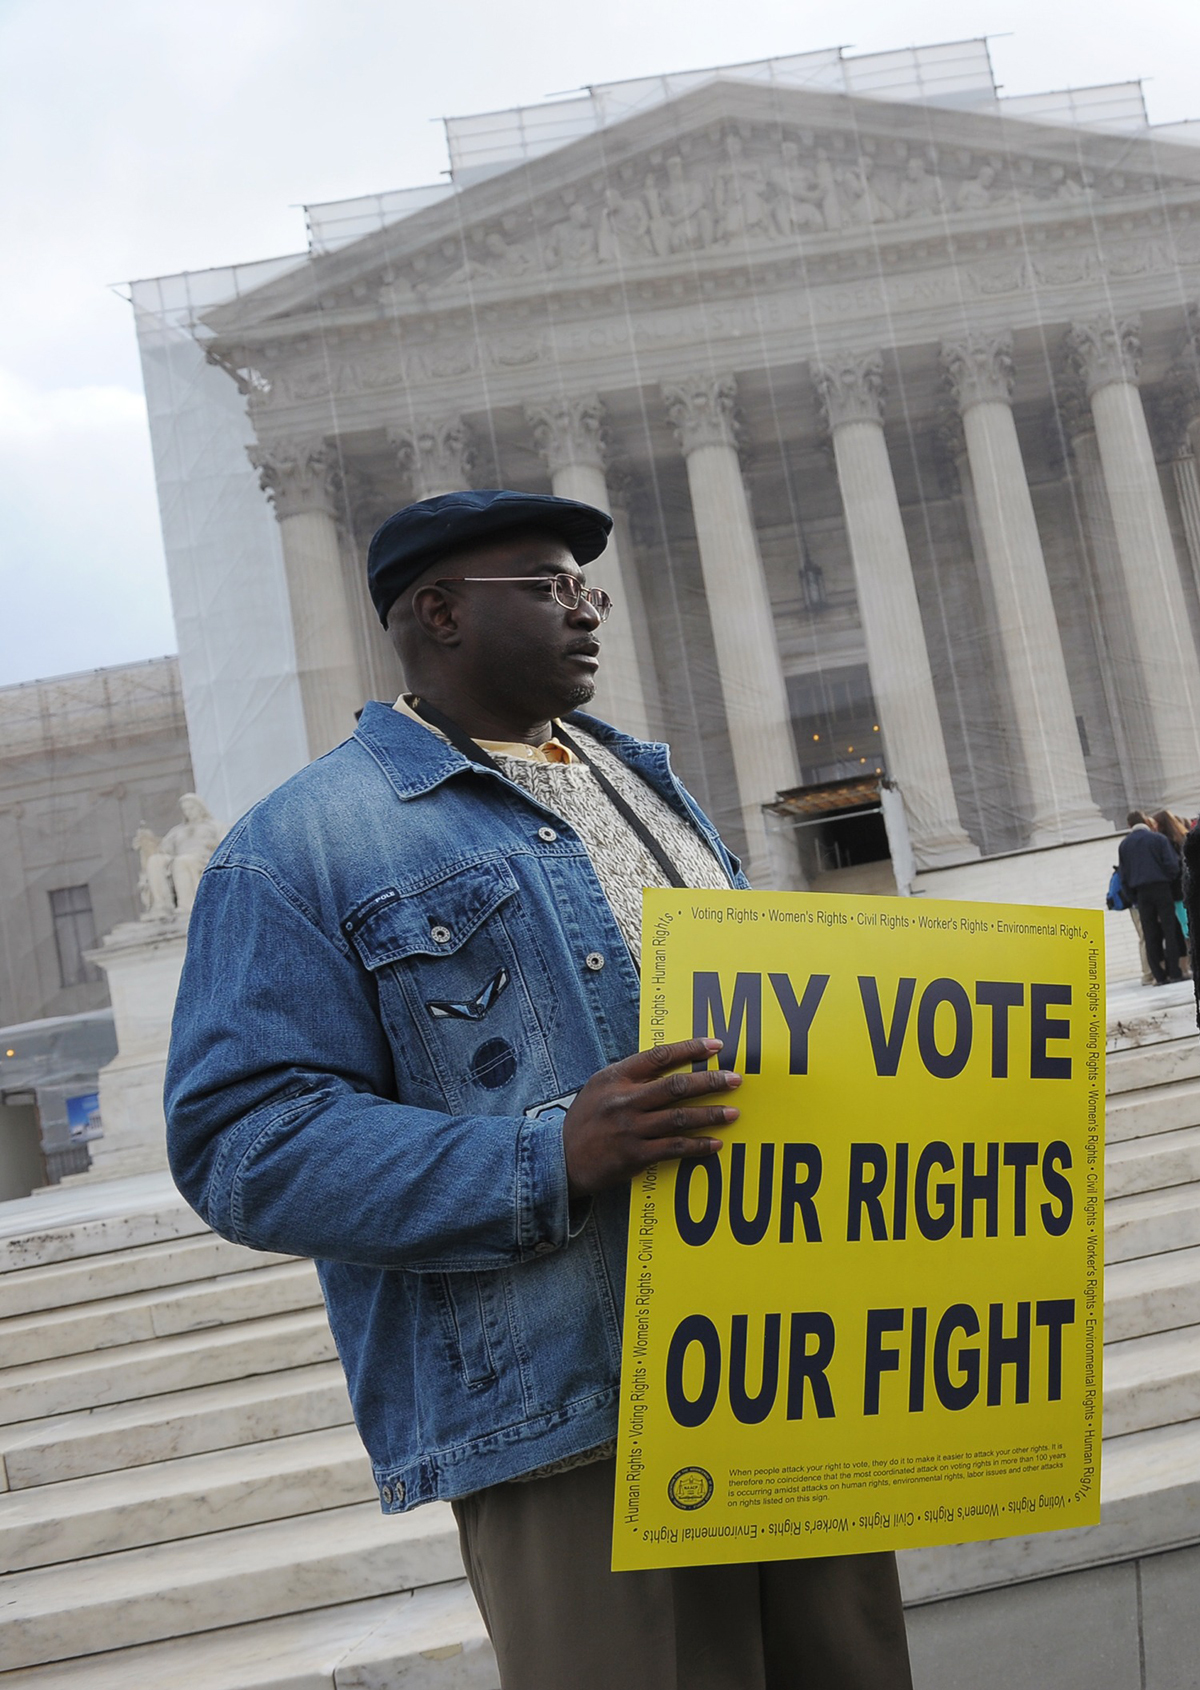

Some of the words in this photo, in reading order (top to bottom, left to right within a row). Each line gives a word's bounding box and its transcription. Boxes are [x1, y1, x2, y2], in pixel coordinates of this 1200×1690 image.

[375, 891, 395, 903] POLE
[652, 912, 674, 947] Rights
[691, 907, 723, 923] Voting
[726, 907, 759, 923] Rights
[768, 909, 814, 923] Women's
[817, 911, 848, 927] Rights
[856, 912, 877, 925] Civil
[880, 914, 909, 929] Rights
[918, 916, 958, 930] Worker's
[960, 918, 989, 934] Rights
[997, 921, 1058, 936] Environmental
[1060, 924, 1089, 940] Rights
[652, 950, 666, 985] Human
[1089, 949, 1099, 980] Human
[651, 993, 669, 1032] Rights
[1086, 983, 1100, 1012] Rights
[692, 972, 829, 1074] MY
[858, 976, 1072, 1080] VOTE
[1086, 1021, 1100, 1049] Voting
[1086, 1052, 1099, 1081] Rights
[1088, 1090, 1098, 1132] Women's
[1085, 1135, 1098, 1164] Rights
[642, 1164, 657, 1193] Work
[674, 1143, 823, 1246] OUR
[847, 1140, 1074, 1243] RIGHTS
[1086, 1174, 1098, 1193] Civil
[640, 1202, 658, 1234] Rights
[1084, 1196, 1097, 1226] Rights
[638, 1240, 653, 1262] Civil
[1086, 1235, 1097, 1278] Worker's
[636, 1273, 654, 1306] Rights
[1085, 1279, 1097, 1310] Rights
[633, 1309, 650, 1358] Women's
[666, 1311, 836, 1428] OUR
[863, 1299, 1075, 1416] FIGHT
[1085, 1319, 1096, 1386] Environmental
[631, 1368, 649, 1402] Rights
[1082, 1389, 1096, 1421] Rights
[629, 1405, 648, 1438] Voting
[754, 1468, 780, 1476] people
[782, 1465, 804, 1473] attack
[806, 1464, 823, 1473] your
[825, 1463, 842, 1471] right
[974, 1449, 994, 1458] attack
[996, 1448, 1010, 1457] your
[1012, 1446, 1029, 1454] other
[1031, 1444, 1049, 1453] rights.
[1084, 1429, 1095, 1464] Human
[627, 1449, 645, 1481] Rights
[737, 1487, 772, 1496] occurring
[774, 1486, 800, 1494] amidst
[801, 1483, 828, 1492] attacks
[842, 1480, 866, 1489] human
[869, 1479, 890, 1488] rights,
[893, 1474, 942, 1485] environmental
[944, 1472, 965, 1481] rights,
[967, 1470, 984, 1478] labor
[986, 1468, 1007, 1476] issues
[1041, 1462, 1063, 1470] attacks
[777, 1475, 821, 1484] coincidence
[873, 1467, 915, 1477] coordinated
[951, 1461, 971, 1470] voting
[973, 1459, 991, 1468] rights
[1049, 1453, 1066, 1461] years
[1075, 1467, 1094, 1502] Rights
[625, 1485, 640, 1523] Human
[740, 1498, 761, 1508] rights
[924, 1506, 954, 1523] Rights
[957, 1503, 999, 1521] Women's
[1008, 1497, 1036, 1513] Rights
[1039, 1494, 1065, 1510] Voting
[642, 1526, 678, 1544] Rights
[682, 1524, 757, 1543] Environmental
[768, 1519, 801, 1535] Rights
[805, 1517, 850, 1534] Worker's
[859, 1513, 890, 1530] Rights
[893, 1512, 914, 1527] Civil
